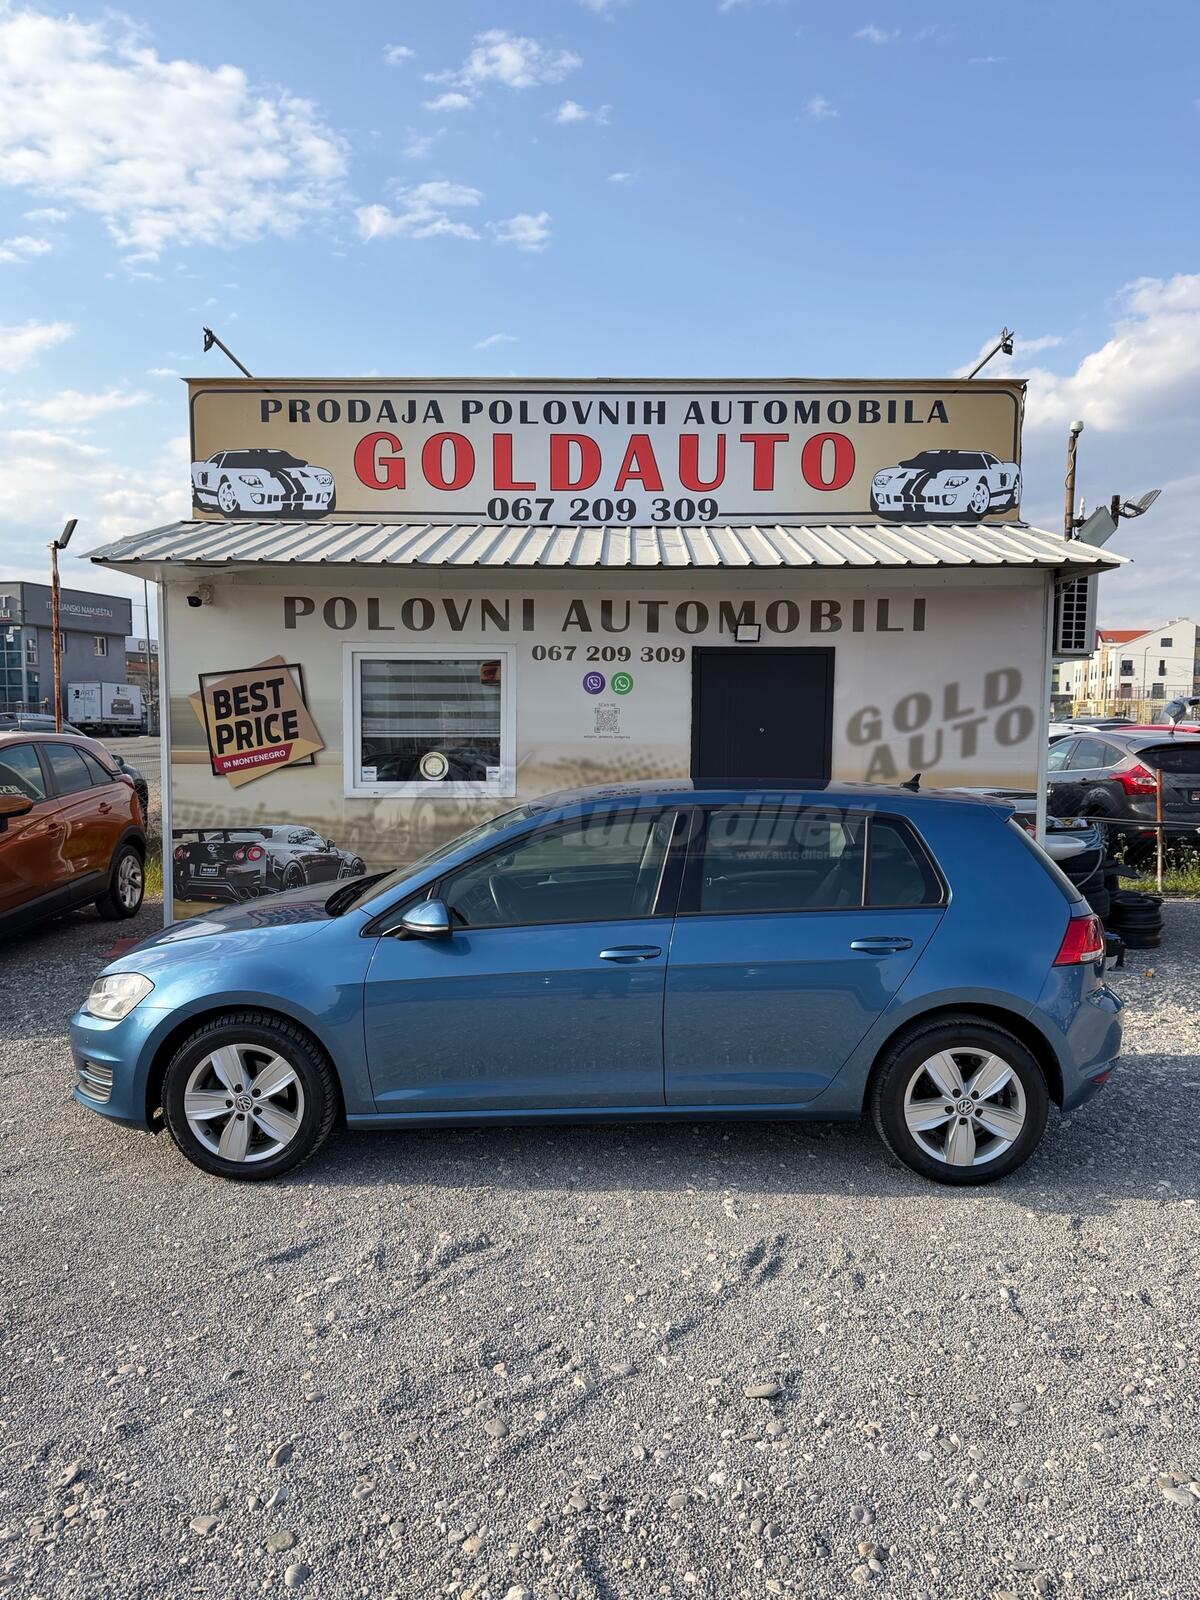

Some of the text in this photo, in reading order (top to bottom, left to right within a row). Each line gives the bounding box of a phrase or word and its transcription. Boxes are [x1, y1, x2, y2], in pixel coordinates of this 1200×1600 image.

[260, 399, 950, 426] PRODAJA POLOVNIH AUTOMOBILA
[353, 430, 857, 493] GOLDAUTO
[486, 497, 720, 523] 067 209 309
[283, 596, 928, 635] POLOVNI AUTOMOBILI
[531, 645, 686, 663] 067 209 309
[213, 677, 285, 720] BEST
[846, 666, 1024, 746] GOLD
[215, 709, 299, 755] PRICE
[865, 704, 1035, 782] AUTO
[223, 749, 286, 769] IN MONTENEGRO
